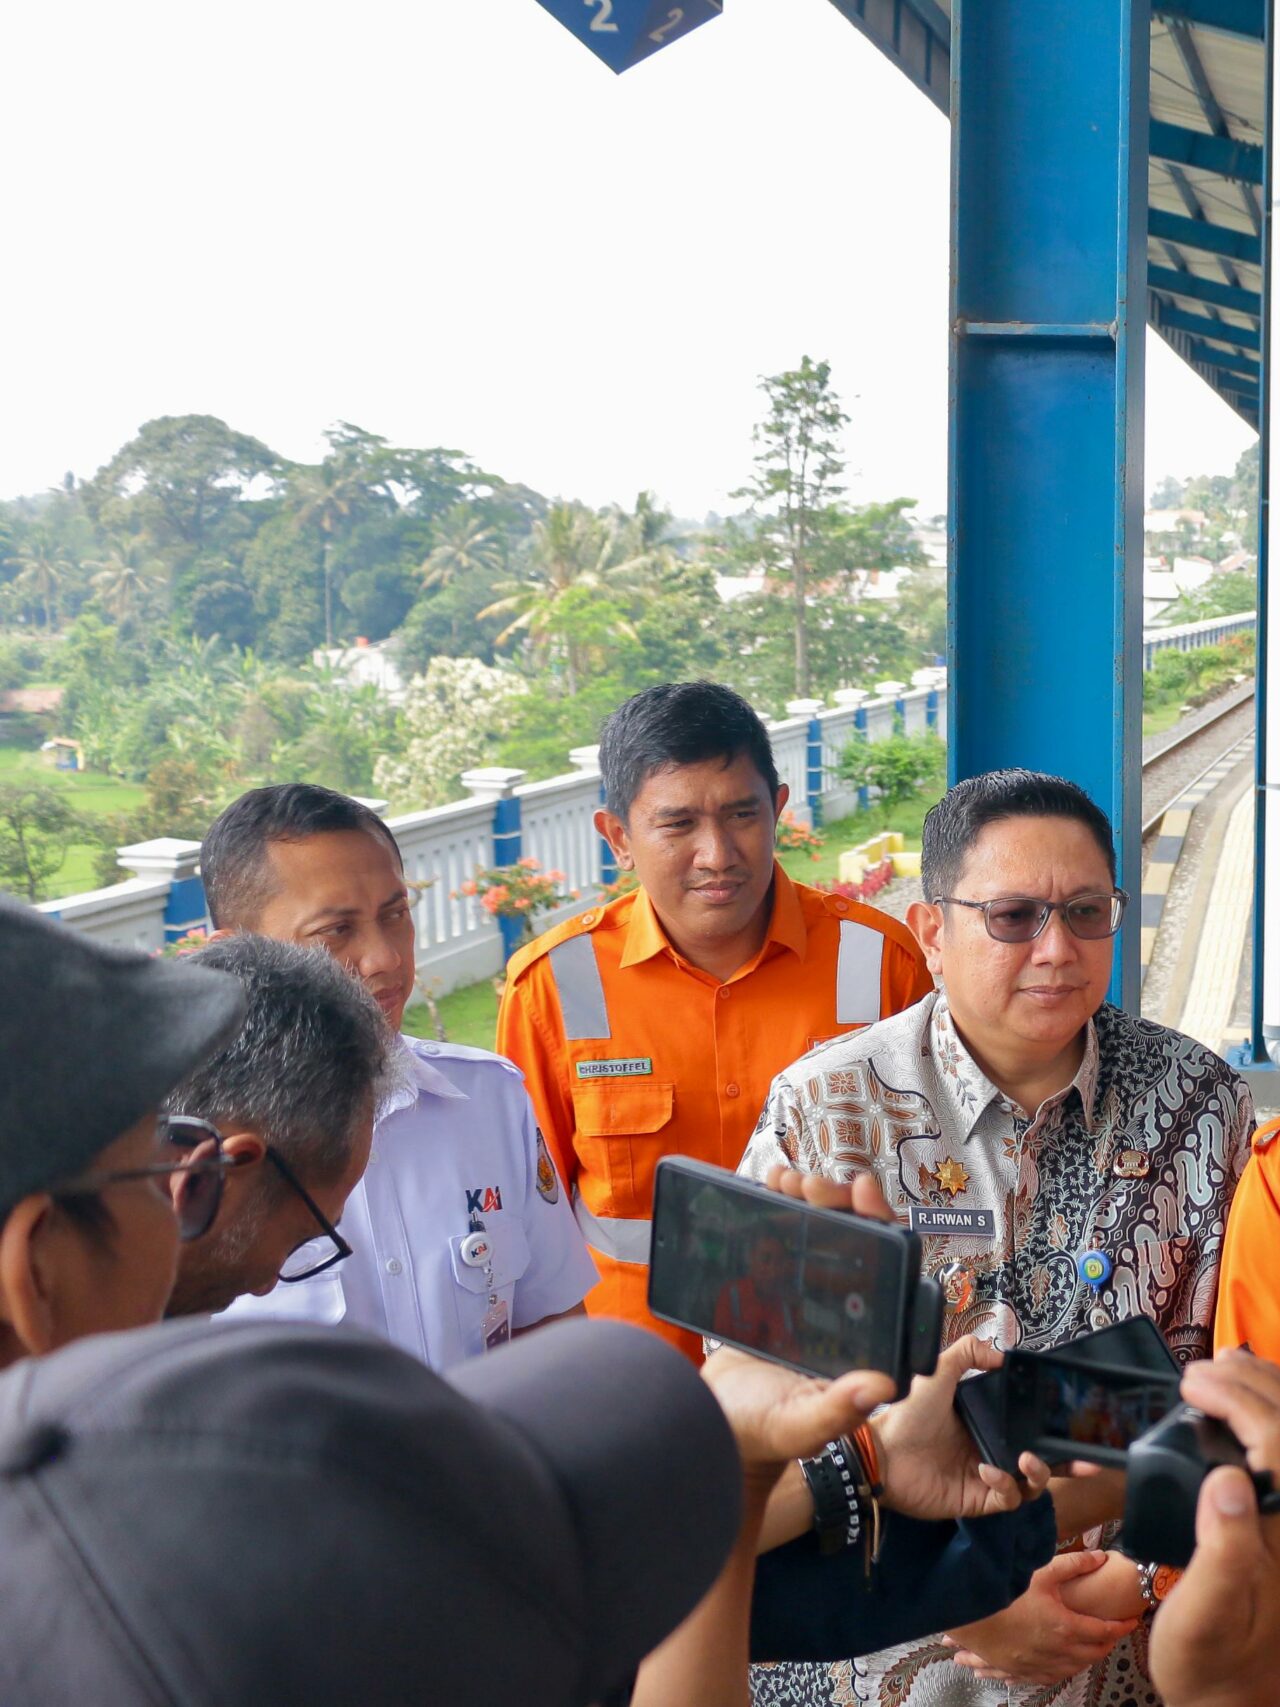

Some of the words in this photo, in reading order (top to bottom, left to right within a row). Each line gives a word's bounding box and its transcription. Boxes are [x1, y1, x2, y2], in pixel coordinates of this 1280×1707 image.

[584, 0, 619, 32] 2
[649, 7, 684, 43] 2
[465, 1186, 503, 1214] KAI
[977, 1215, 986, 1227] S
